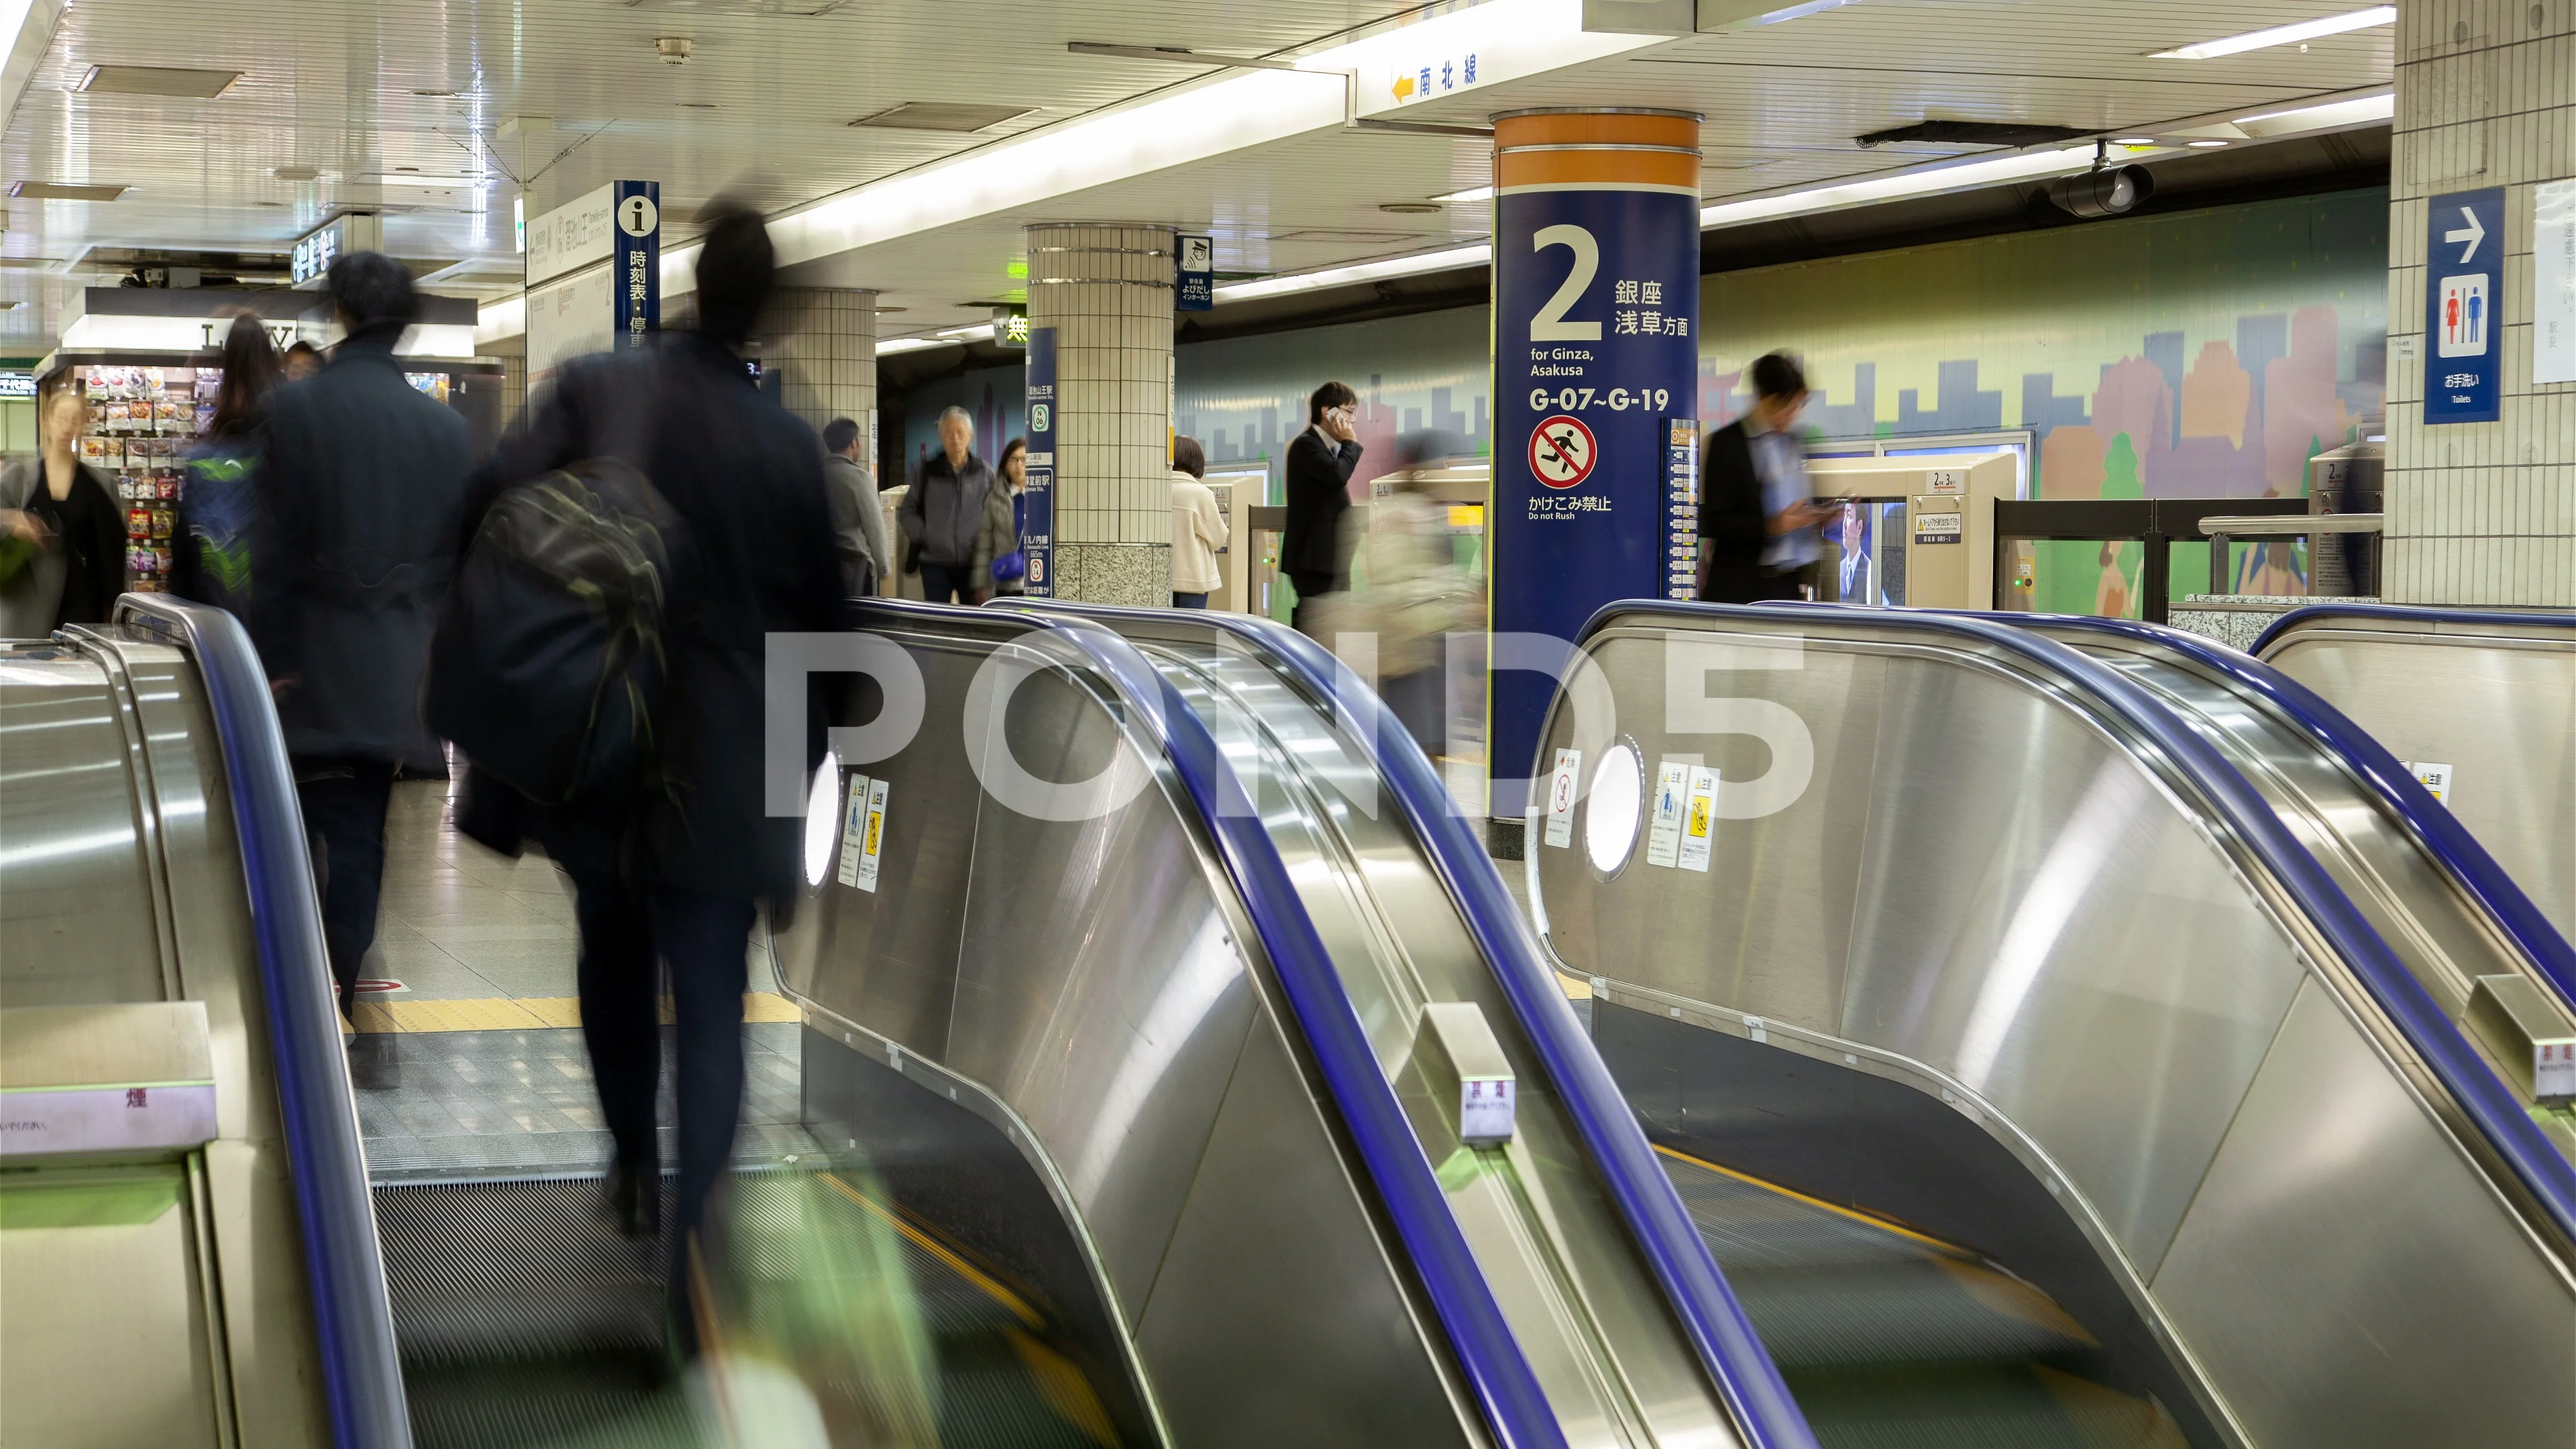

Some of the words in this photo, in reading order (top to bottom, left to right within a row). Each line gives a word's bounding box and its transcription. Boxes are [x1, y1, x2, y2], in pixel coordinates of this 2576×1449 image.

[1420, 52, 1476, 97] 南北線
[1182, 284, 1210, 294] よびだし
[1530, 224, 1602, 341] 2
[1615, 280, 1662, 305] 銀座
[1615, 310, 1688, 337] 浅草方面
[1530, 348, 1548, 360] for
[1552, 348, 1594, 361] Ginza,
[1530, 364, 1583, 376] Asakusa
[2445, 373, 2479, 388] お手洗い
[2452, 395, 2471, 404] Toilets
[1529, 496, 1611, 511] かけこみ禁止
